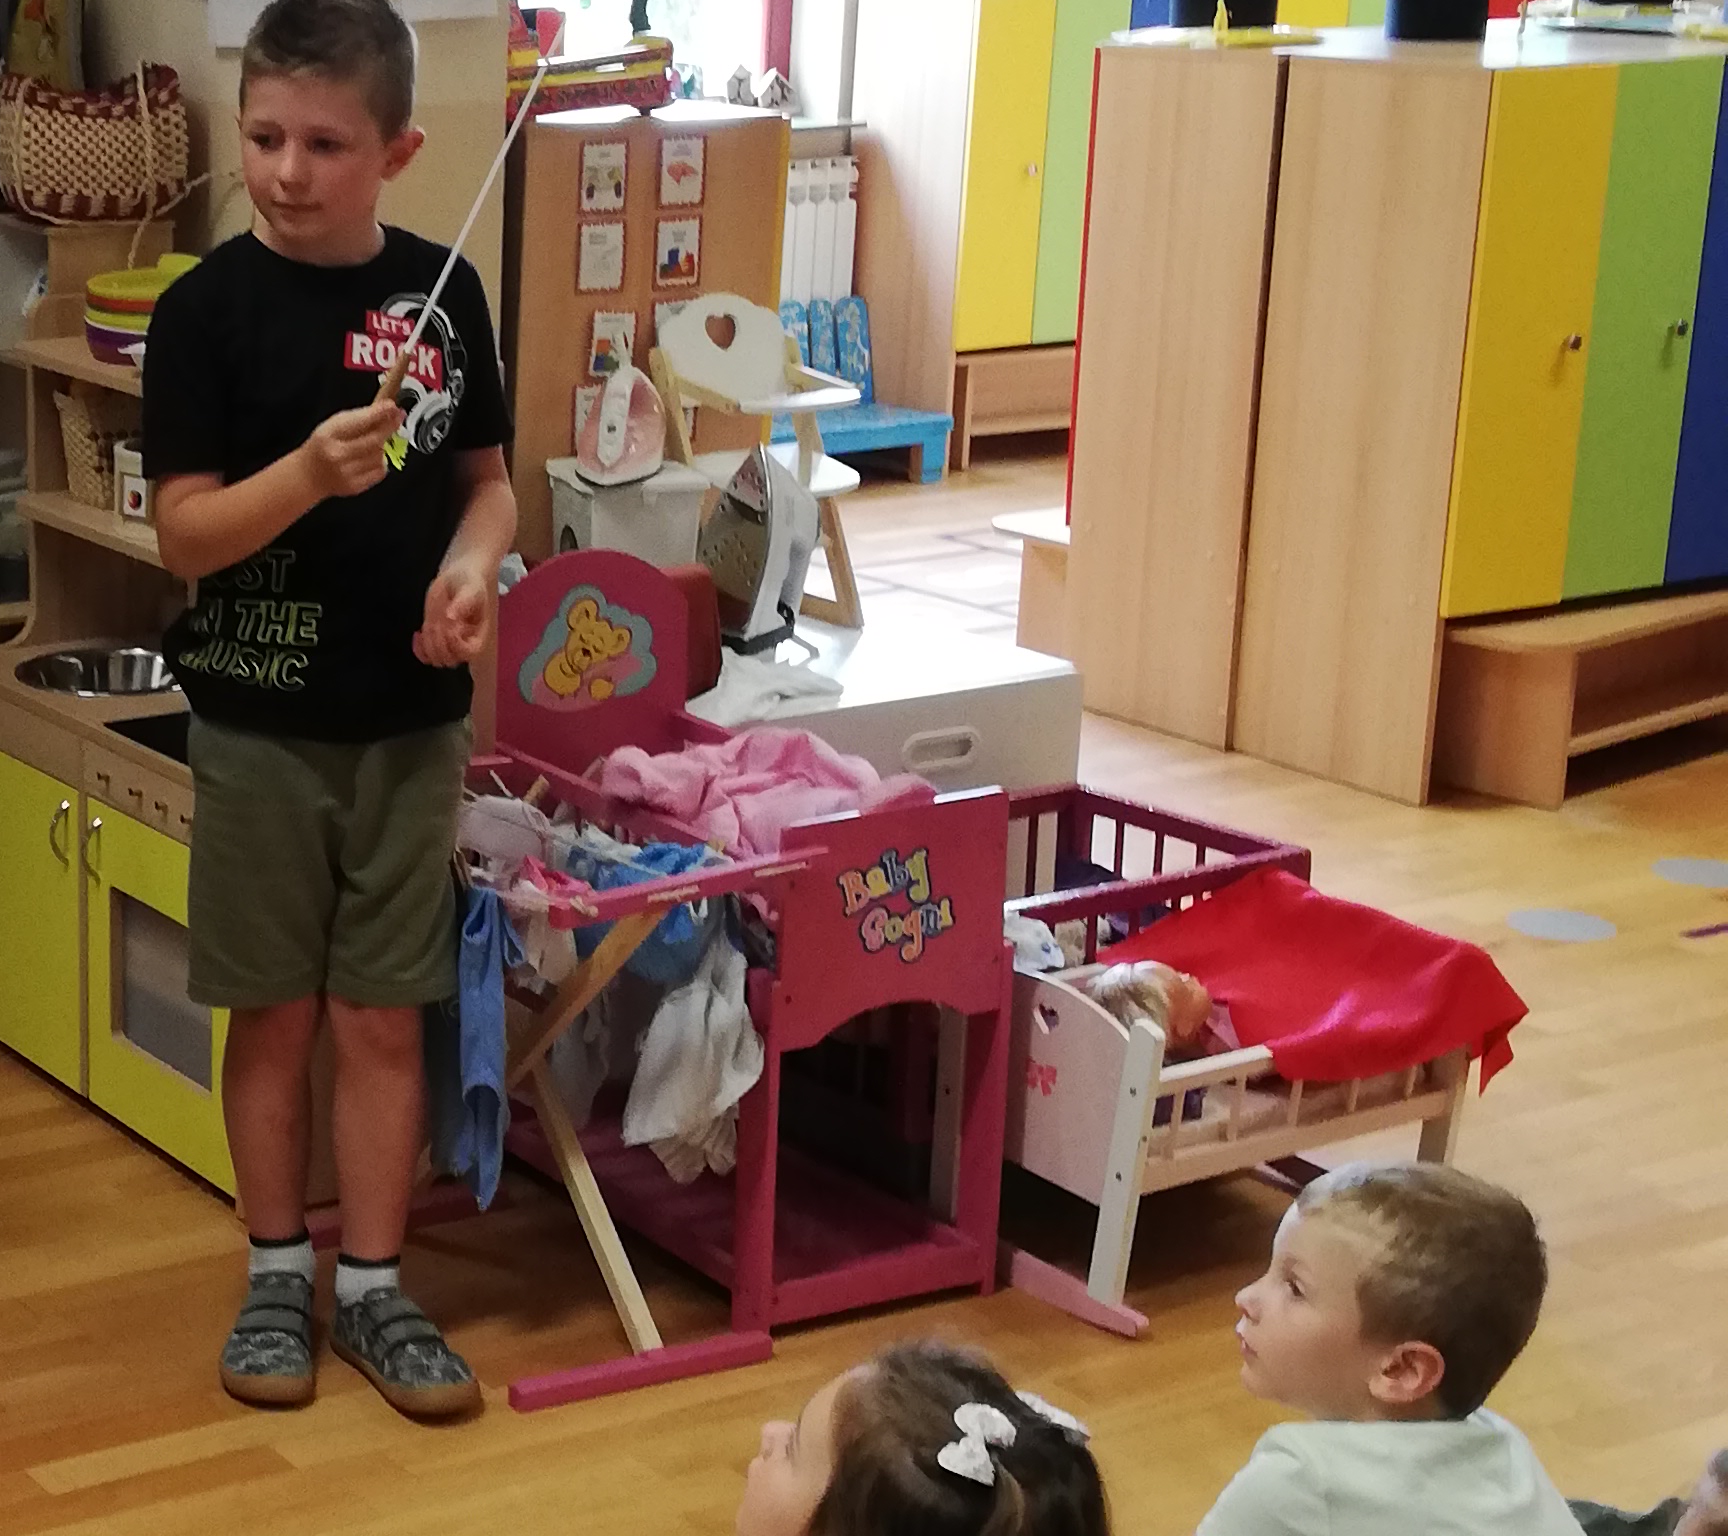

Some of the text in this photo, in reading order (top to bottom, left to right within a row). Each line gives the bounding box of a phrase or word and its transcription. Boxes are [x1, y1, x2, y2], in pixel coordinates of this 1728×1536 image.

[371, 313, 414, 337] LET'S
[234, 599, 323, 648] THE
[837, 848, 930, 917] Baby
